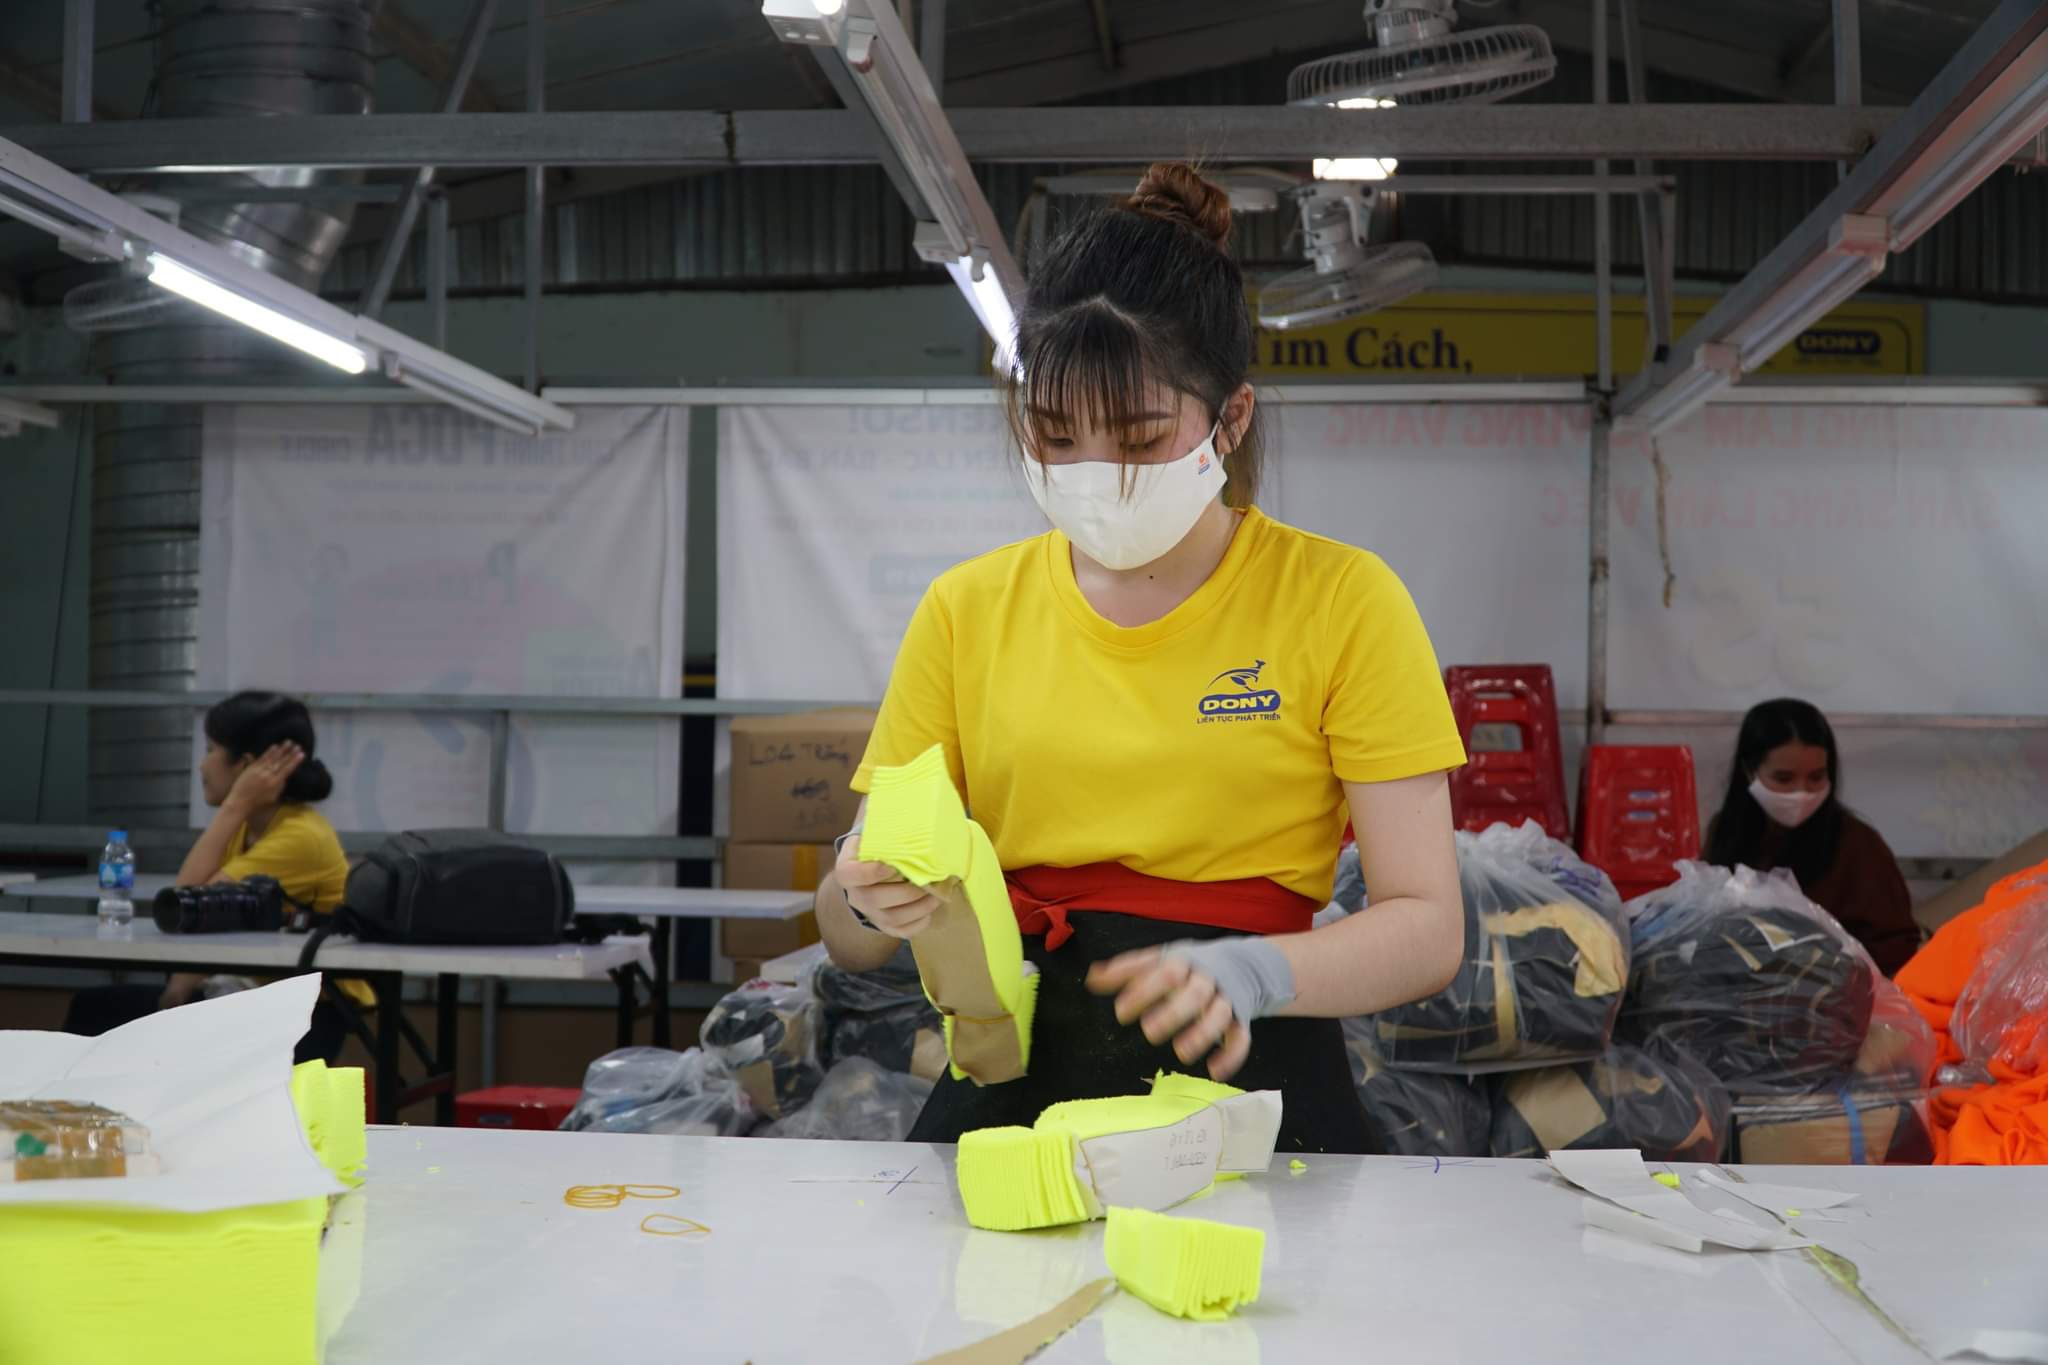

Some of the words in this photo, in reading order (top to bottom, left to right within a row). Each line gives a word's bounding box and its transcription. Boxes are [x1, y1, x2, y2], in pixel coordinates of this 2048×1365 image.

[1346, 326, 1473, 374] Cách,
[1802, 335, 1873, 349] DONY
[1203, 694, 1276, 711] DONY
